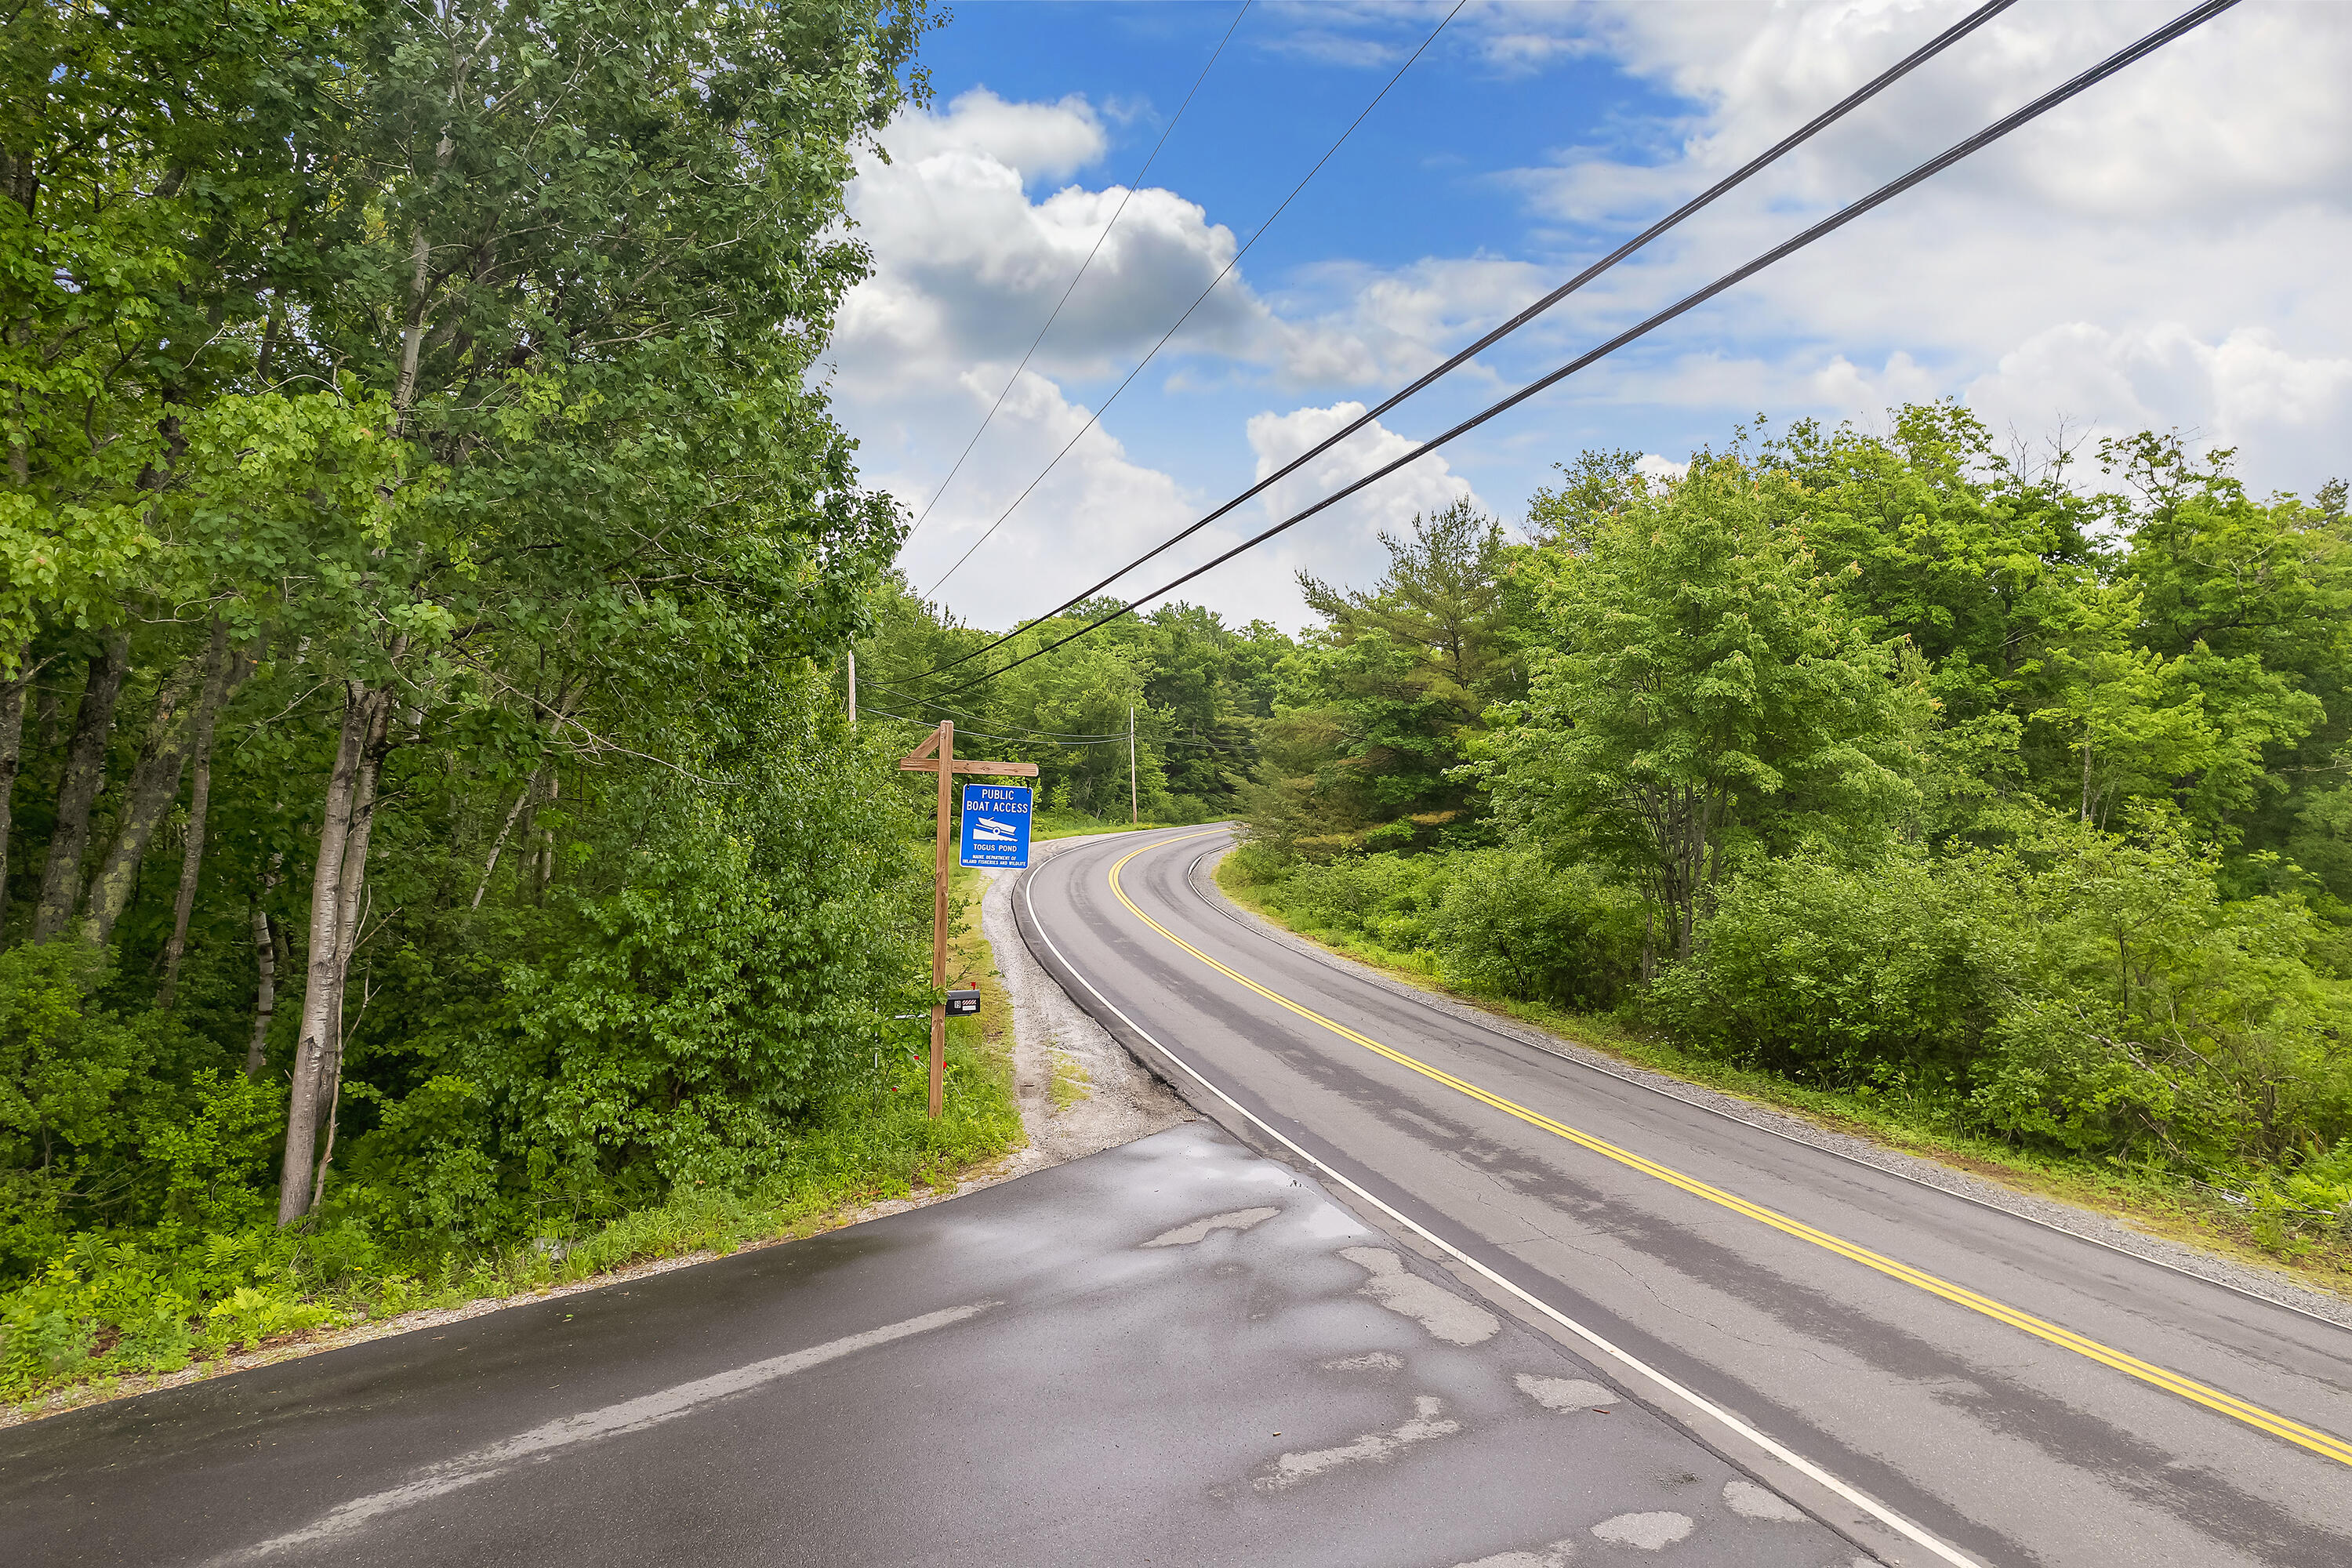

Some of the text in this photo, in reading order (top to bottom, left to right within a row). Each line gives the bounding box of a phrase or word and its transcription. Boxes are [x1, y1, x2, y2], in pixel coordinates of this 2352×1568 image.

[982, 789, 1014, 800] PUBLIC
[966, 800, 1028, 814] BOAT ACCESS
